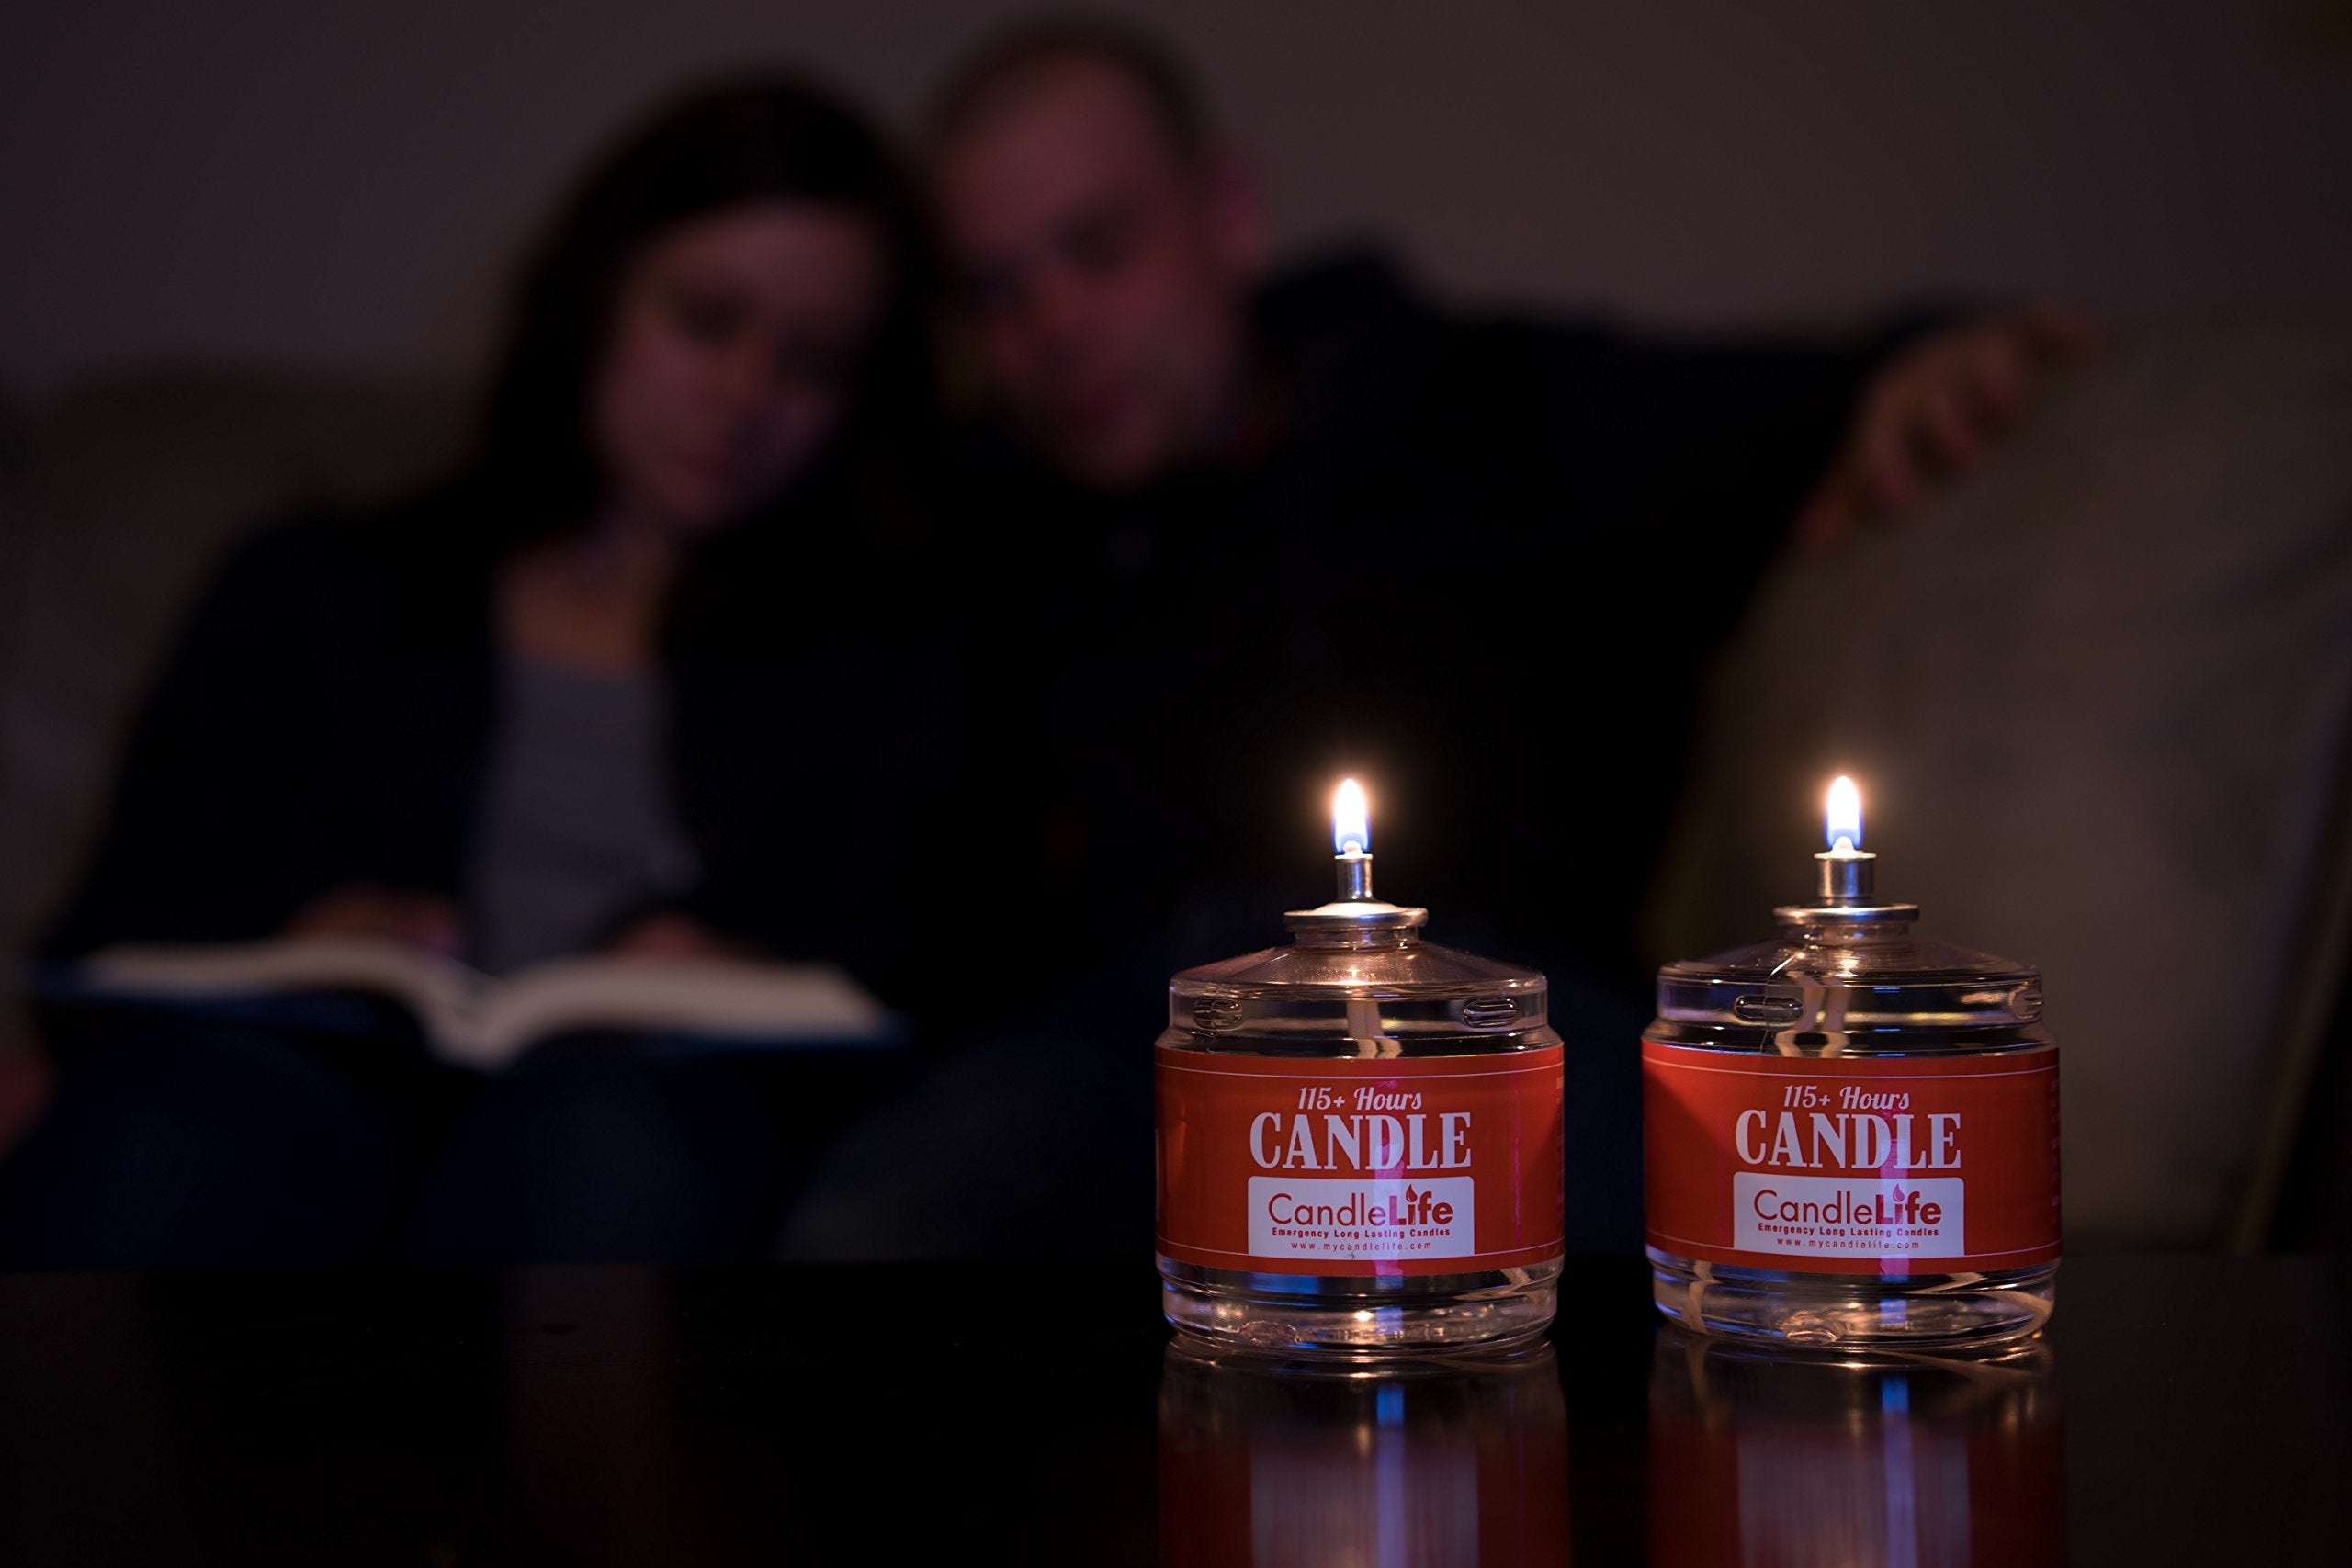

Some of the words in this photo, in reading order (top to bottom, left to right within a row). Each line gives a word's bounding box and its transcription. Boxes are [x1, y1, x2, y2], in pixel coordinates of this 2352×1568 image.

[1298, 1087, 1346, 1110] 115+
[1353, 1087, 1422, 1111] Hours
[1783, 1084, 1831, 1109] 115+
[1839, 1086, 1910, 1110] Hours
[1250, 1111, 1471, 1170] CANDLE
[1735, 1109, 1962, 1169] CANDLE
[1268, 1184, 1453, 1226] CandleLife
[1754, 1183, 1942, 1225] CandleLife
[1272, 1227, 1329, 1239] Emergency
[1334, 1229, 1360, 1240] Long
[1364, 1229, 1405, 1239] Lasting
[1409, 1227, 1451, 1237] Candles
[1758, 1223, 1815, 1235] Emergency
[1819, 1226, 1846, 1237] Long
[1850, 1227, 1892, 1238] Lasting
[1896, 1227, 1939, 1237] Candles
[1777, 1237, 1919, 1249] www.mycandlelife.com
[1291, 1241, 1432, 1252] www.mycandlelife.com
